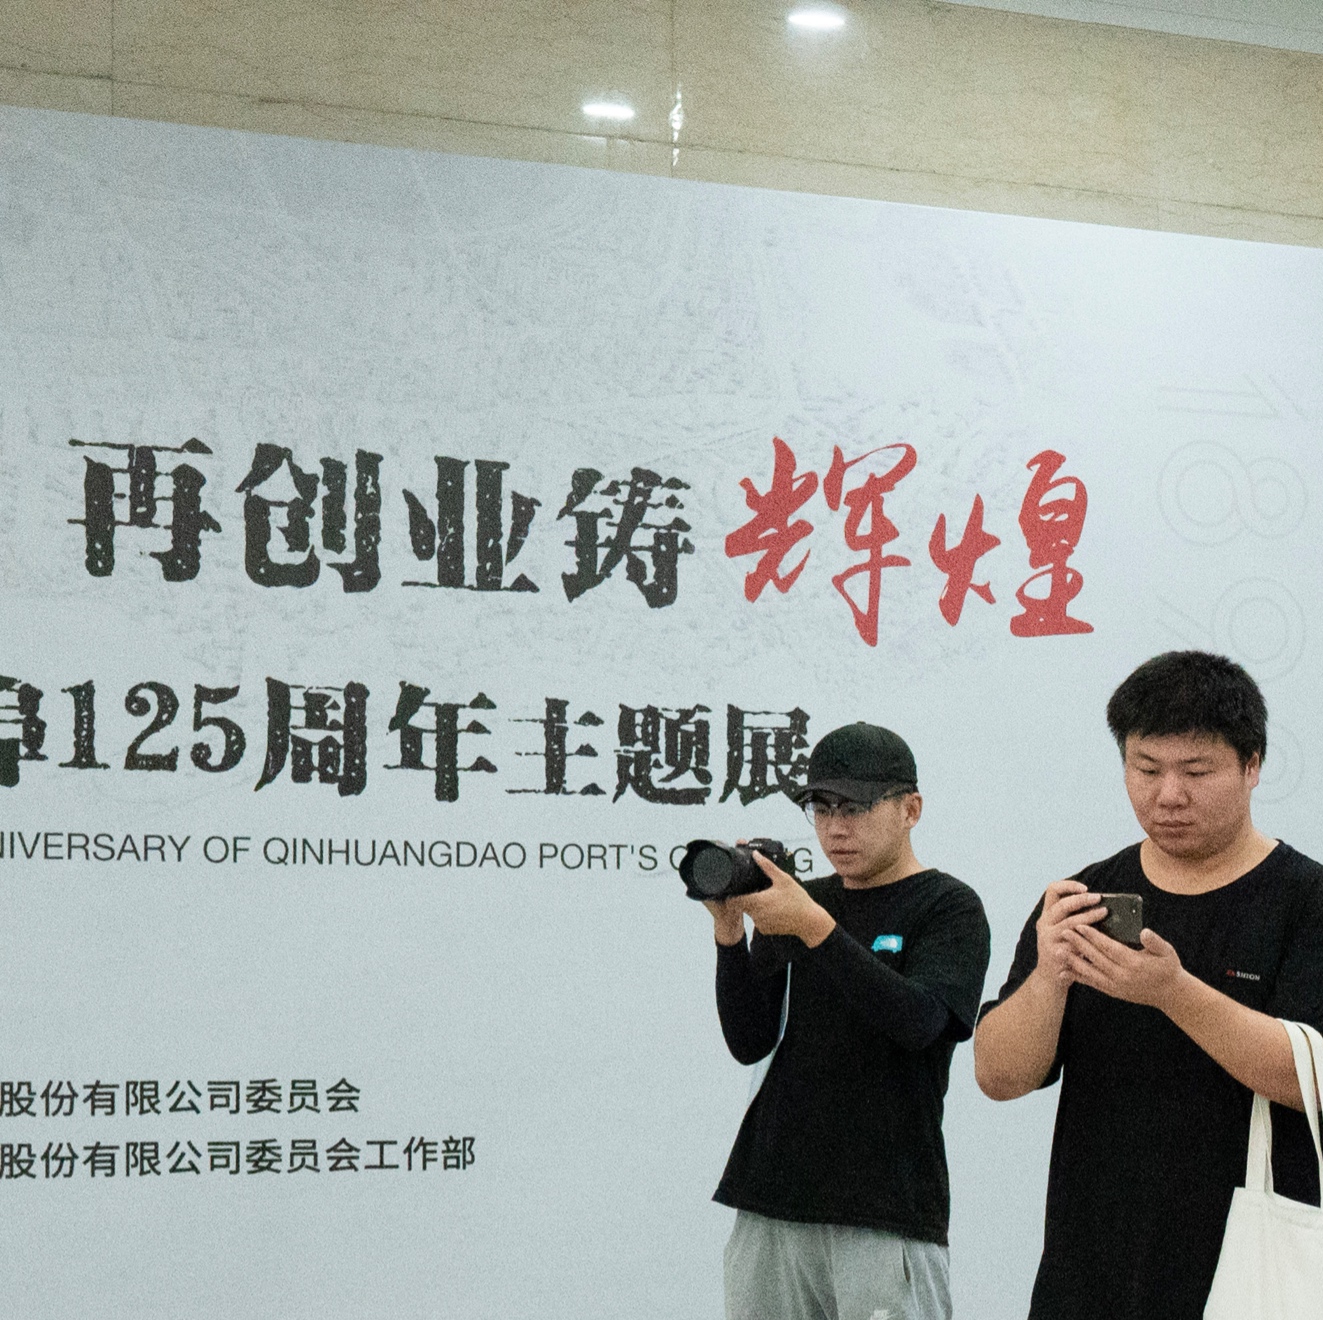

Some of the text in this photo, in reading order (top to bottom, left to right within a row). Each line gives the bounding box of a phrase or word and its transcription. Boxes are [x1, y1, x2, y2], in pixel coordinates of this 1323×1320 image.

[68, 436, 1094, 647] 再创业铸辉煌
[203, 835, 251, 864] OF
[263, 837, 527, 872] QINHUANGDAO
[539, 842, 658, 874] PORT'S
[0, 1077, 361, 1118] 股份有限公司委员会
[0, 1135, 476, 1179] 股份有限公司委员会工作部
